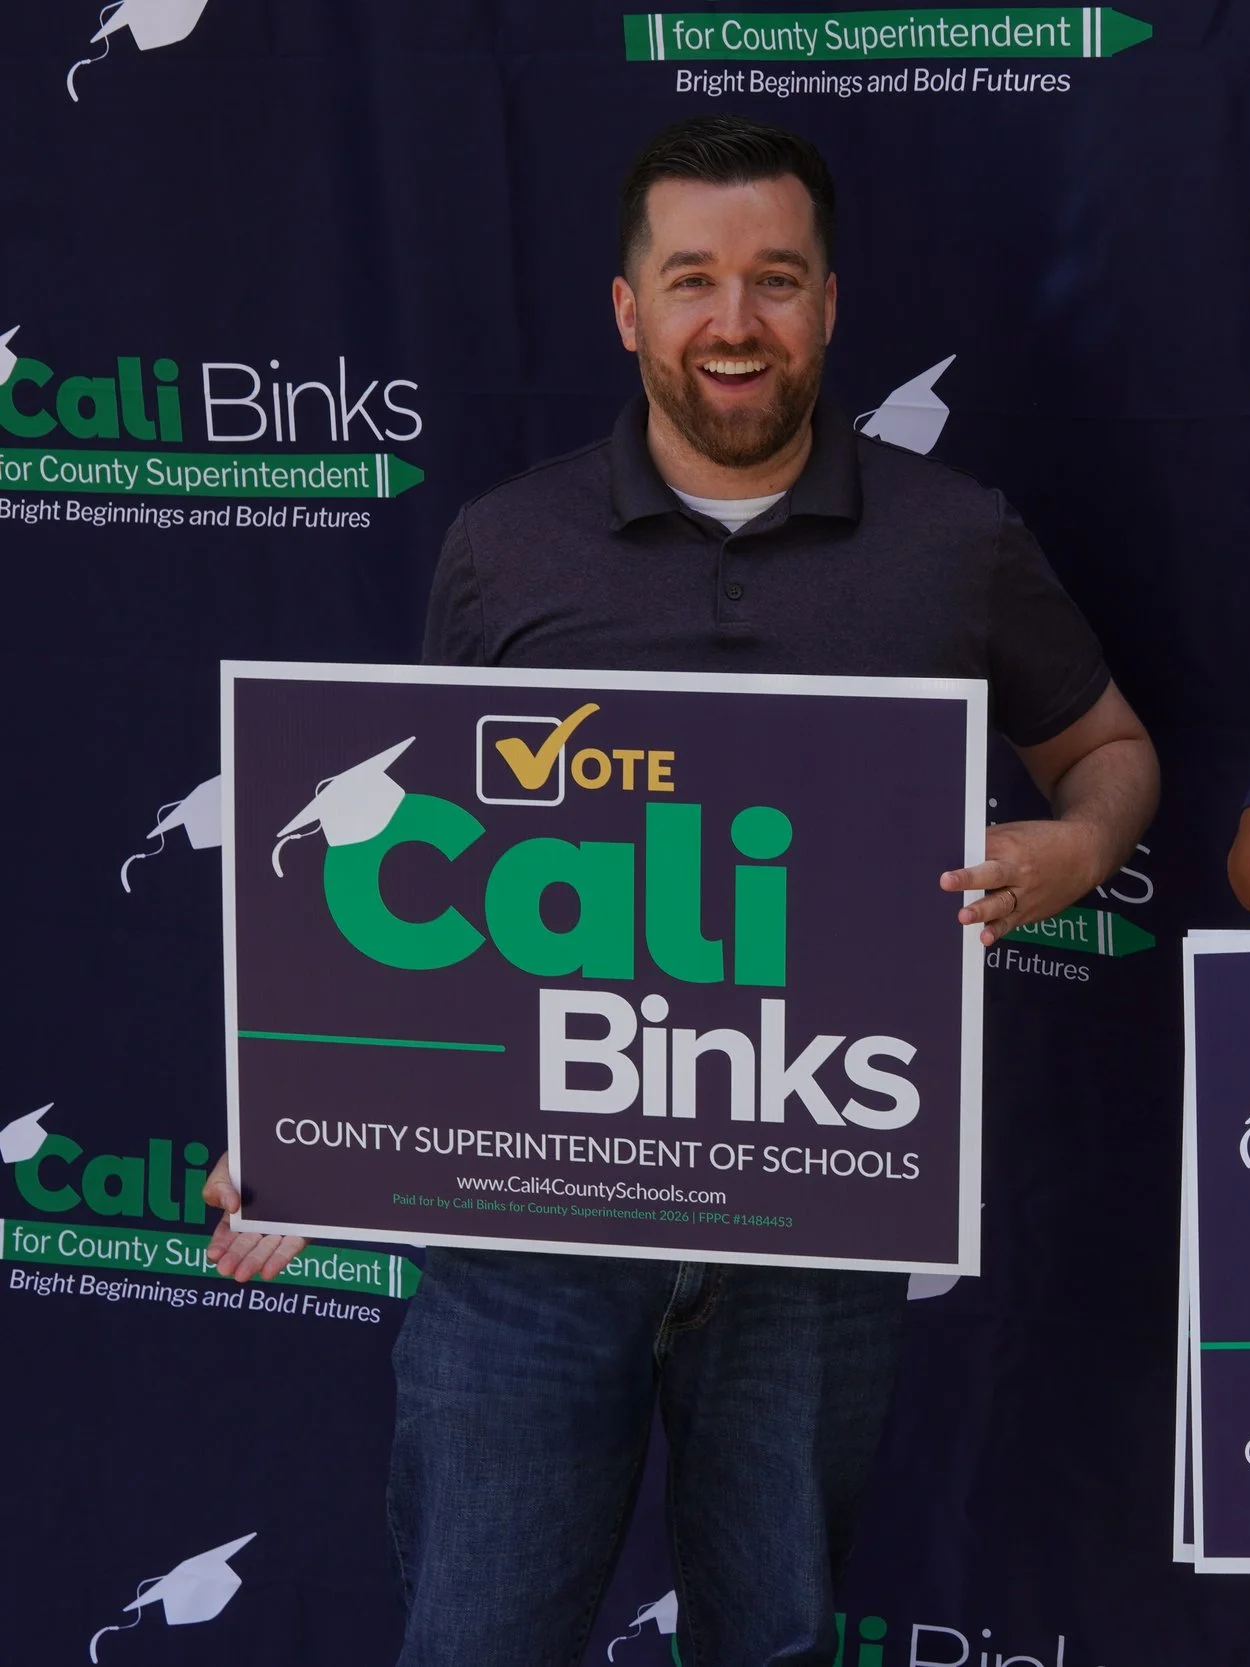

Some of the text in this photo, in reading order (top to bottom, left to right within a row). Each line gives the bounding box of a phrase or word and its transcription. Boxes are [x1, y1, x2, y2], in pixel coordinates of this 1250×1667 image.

[673, 16, 1071, 55] for County Superintendent
[676, 67, 1072, 97] Bright Beginnings and Bold Futures
[0, 356, 424, 442] Cali Binks
[39, 455, 139, 490] County
[146, 457, 370, 491] Superintendent
[0, 498, 371, 528] Bright Beginnings and Bold Futures
[323, 793, 793, 987] Cali
[1006, 949, 1090, 982] Futures
[539, 988, 922, 1130] Binks
[275, 1117, 920, 1180] COUNTY SUPERINTENDENT OF SCHOOLS
[15, 1134, 209, 1224] Cali
[457, 1175, 726, 1205] www.Cali4CountySchools.com
[393, 1193, 416, 1206] Paid
[419, 1195, 433, 1207] for
[436, 1196, 450, 1210] by
[453, 1197, 473, 1209] Cali
[476, 1198, 506, 1212] Binks
[509, 1200, 525, 1213] for
[528, 1202, 568, 1217] County
[571, 1204, 657, 1221] Superintendent
[659, 1209, 689, 1222] 2026
[699, 1212, 730, 1225] FPPC
[733, 1214, 793, 1228] #1484453
[12, 1226, 51, 1254] for
[58, 1230, 158, 1267] County
[10, 1269, 381, 1324] Bright Beginnings and Bold Futures
